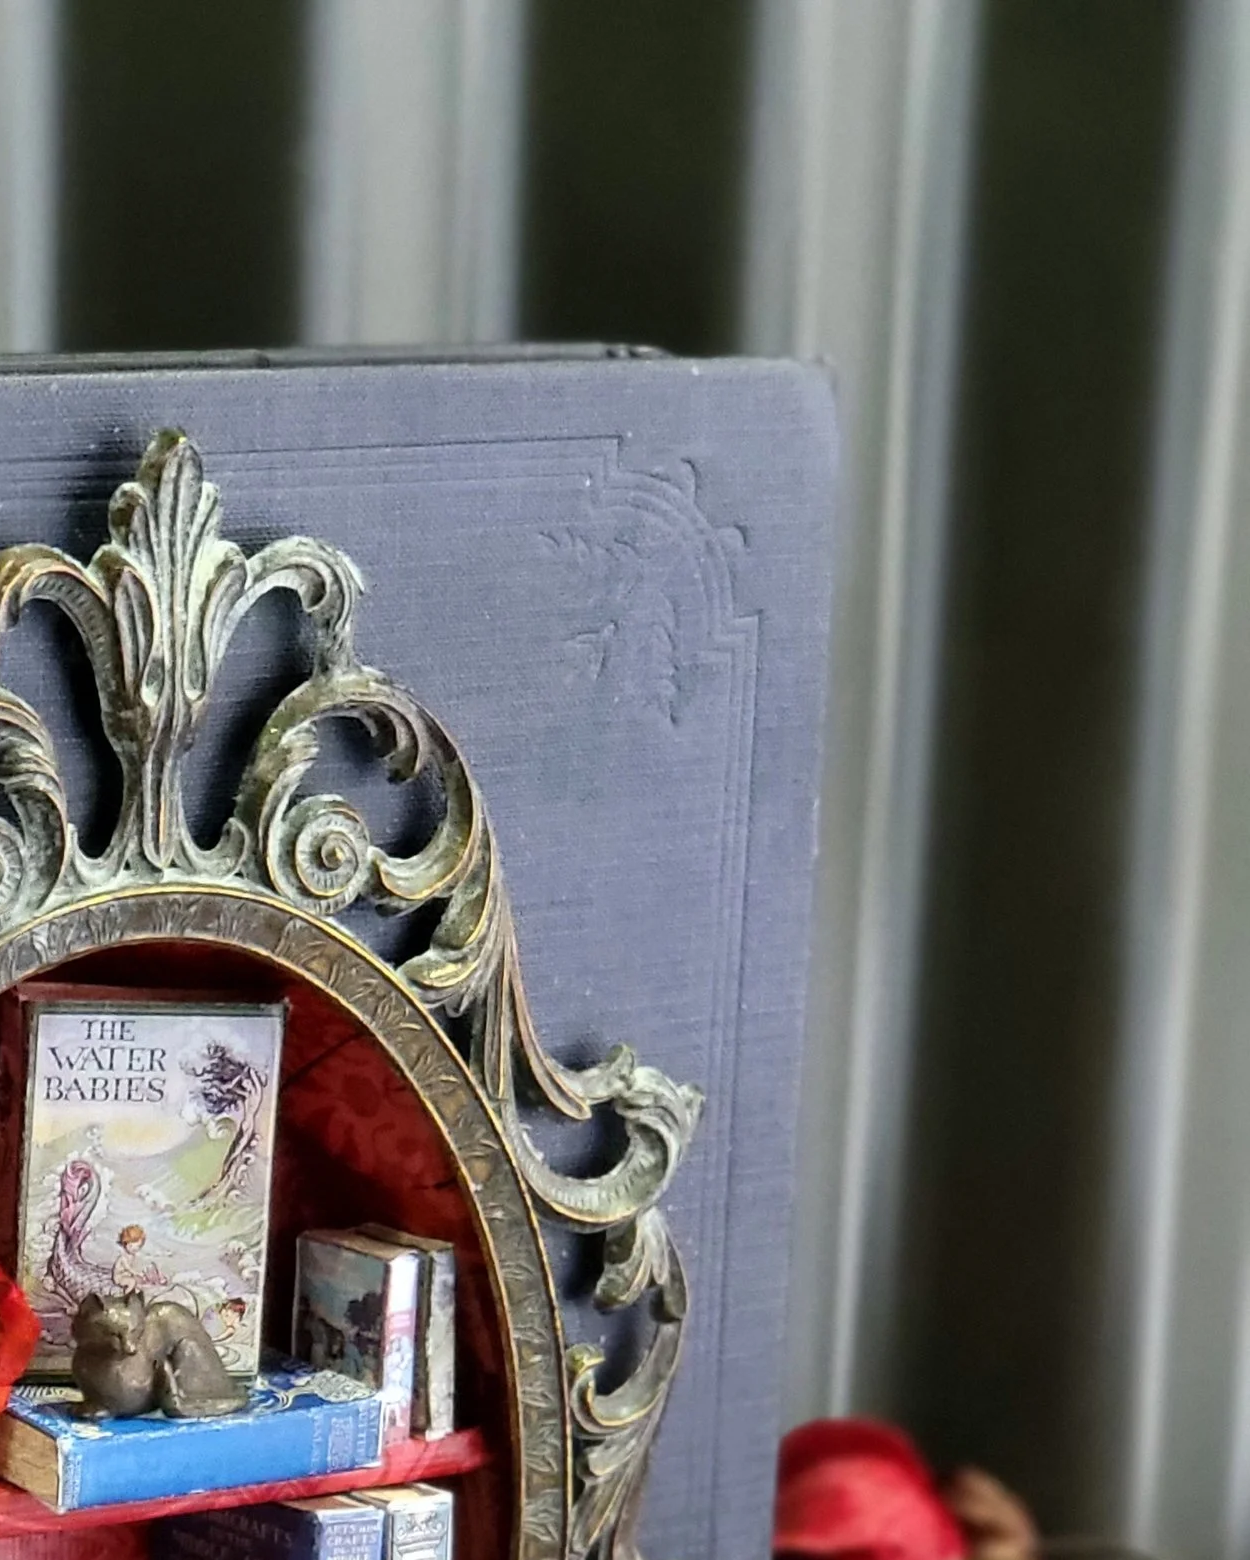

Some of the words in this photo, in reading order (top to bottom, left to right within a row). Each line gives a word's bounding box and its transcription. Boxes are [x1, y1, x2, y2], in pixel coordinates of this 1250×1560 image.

[81, 1019, 135, 1041] THE
[48, 1046, 166, 1072] WATER
[44, 1076, 166, 1102] BABIES
[326, 1534, 377, 1546] CRAFTS
